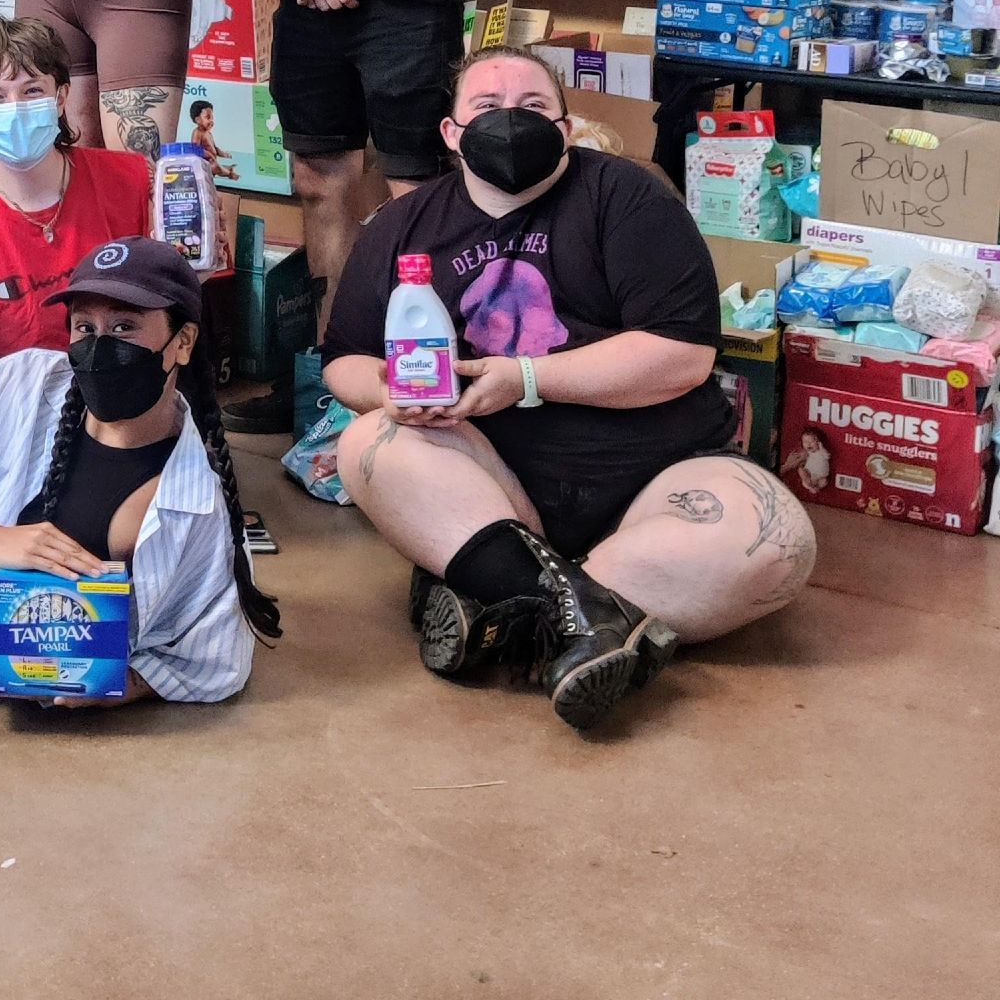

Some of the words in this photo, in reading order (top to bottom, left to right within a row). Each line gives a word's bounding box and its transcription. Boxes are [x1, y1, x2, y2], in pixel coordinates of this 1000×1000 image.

[184, 84, 207, 97] Soft
[269, 134, 283, 144] 132
[842, 142, 949, 202] Baby
[164, 191, 198, 201] ANTACID
[863, 190, 945, 228] Wipes
[806, 225, 864, 244] diapers
[452, 241, 497, 276] DEAD
[219, 357, 231, 383] 5
[400, 360, 433, 369] Similac
[809, 397, 940, 444] HUGGIES
[844, 433, 875, 447] little
[877, 441, 938, 461] snugglers
[945, 511, 961, 528] n
[9, 625, 93, 644] TAMPAX
